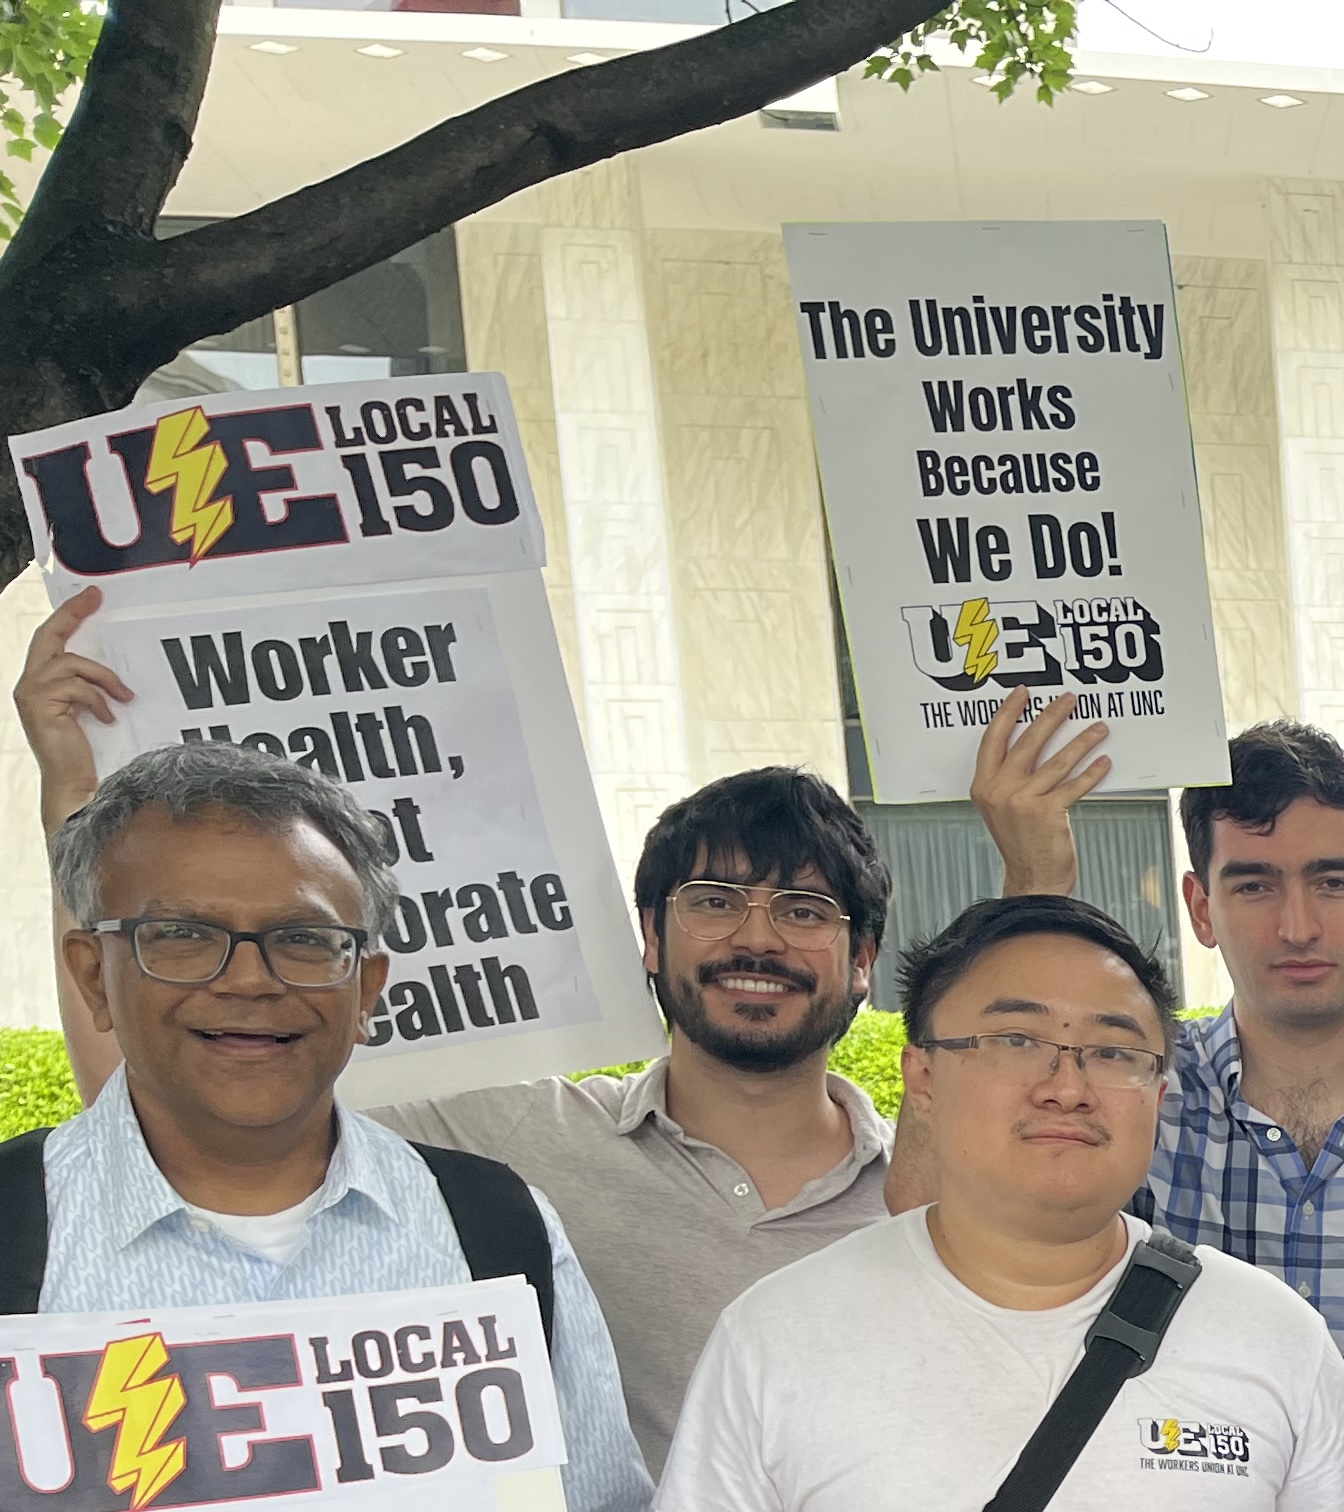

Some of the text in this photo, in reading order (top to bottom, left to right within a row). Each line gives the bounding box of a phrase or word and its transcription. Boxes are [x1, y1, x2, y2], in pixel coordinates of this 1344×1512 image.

[800, 294, 1164, 360] The University
[325, 393, 496, 447] LOCAL
[922, 378, 1075, 432] Works
[23, 404, 349, 576] UE
[341, 440, 520, 538] 150
[916, 449, 1100, 497] Because
[916, 512, 1122, 584] We Do!
[1055, 597, 1152, 625] LOCAL
[162, 621, 457, 709] Worker
[900, 598, 1063, 690] UE
[1059, 621, 1164, 684] 150
[920, 689, 1165, 728] THE AT UNC
[383, 870, 571, 954] orate
[362, 956, 539, 1048] ealth
[310, 1315, 516, 1386] LOCAL
[325, 1369, 536, 1485] 150
[1137, 1418, 1208, 1457] UE
[1206, 1423, 1245, 1437] LOCAL
[1208, 1435, 1249, 1462] 150
[1140, 1458, 1155, 1469] THE
[1158, 1459, 1199, 1472] WORKERS
[1202, 1462, 1224, 1473] UNION
